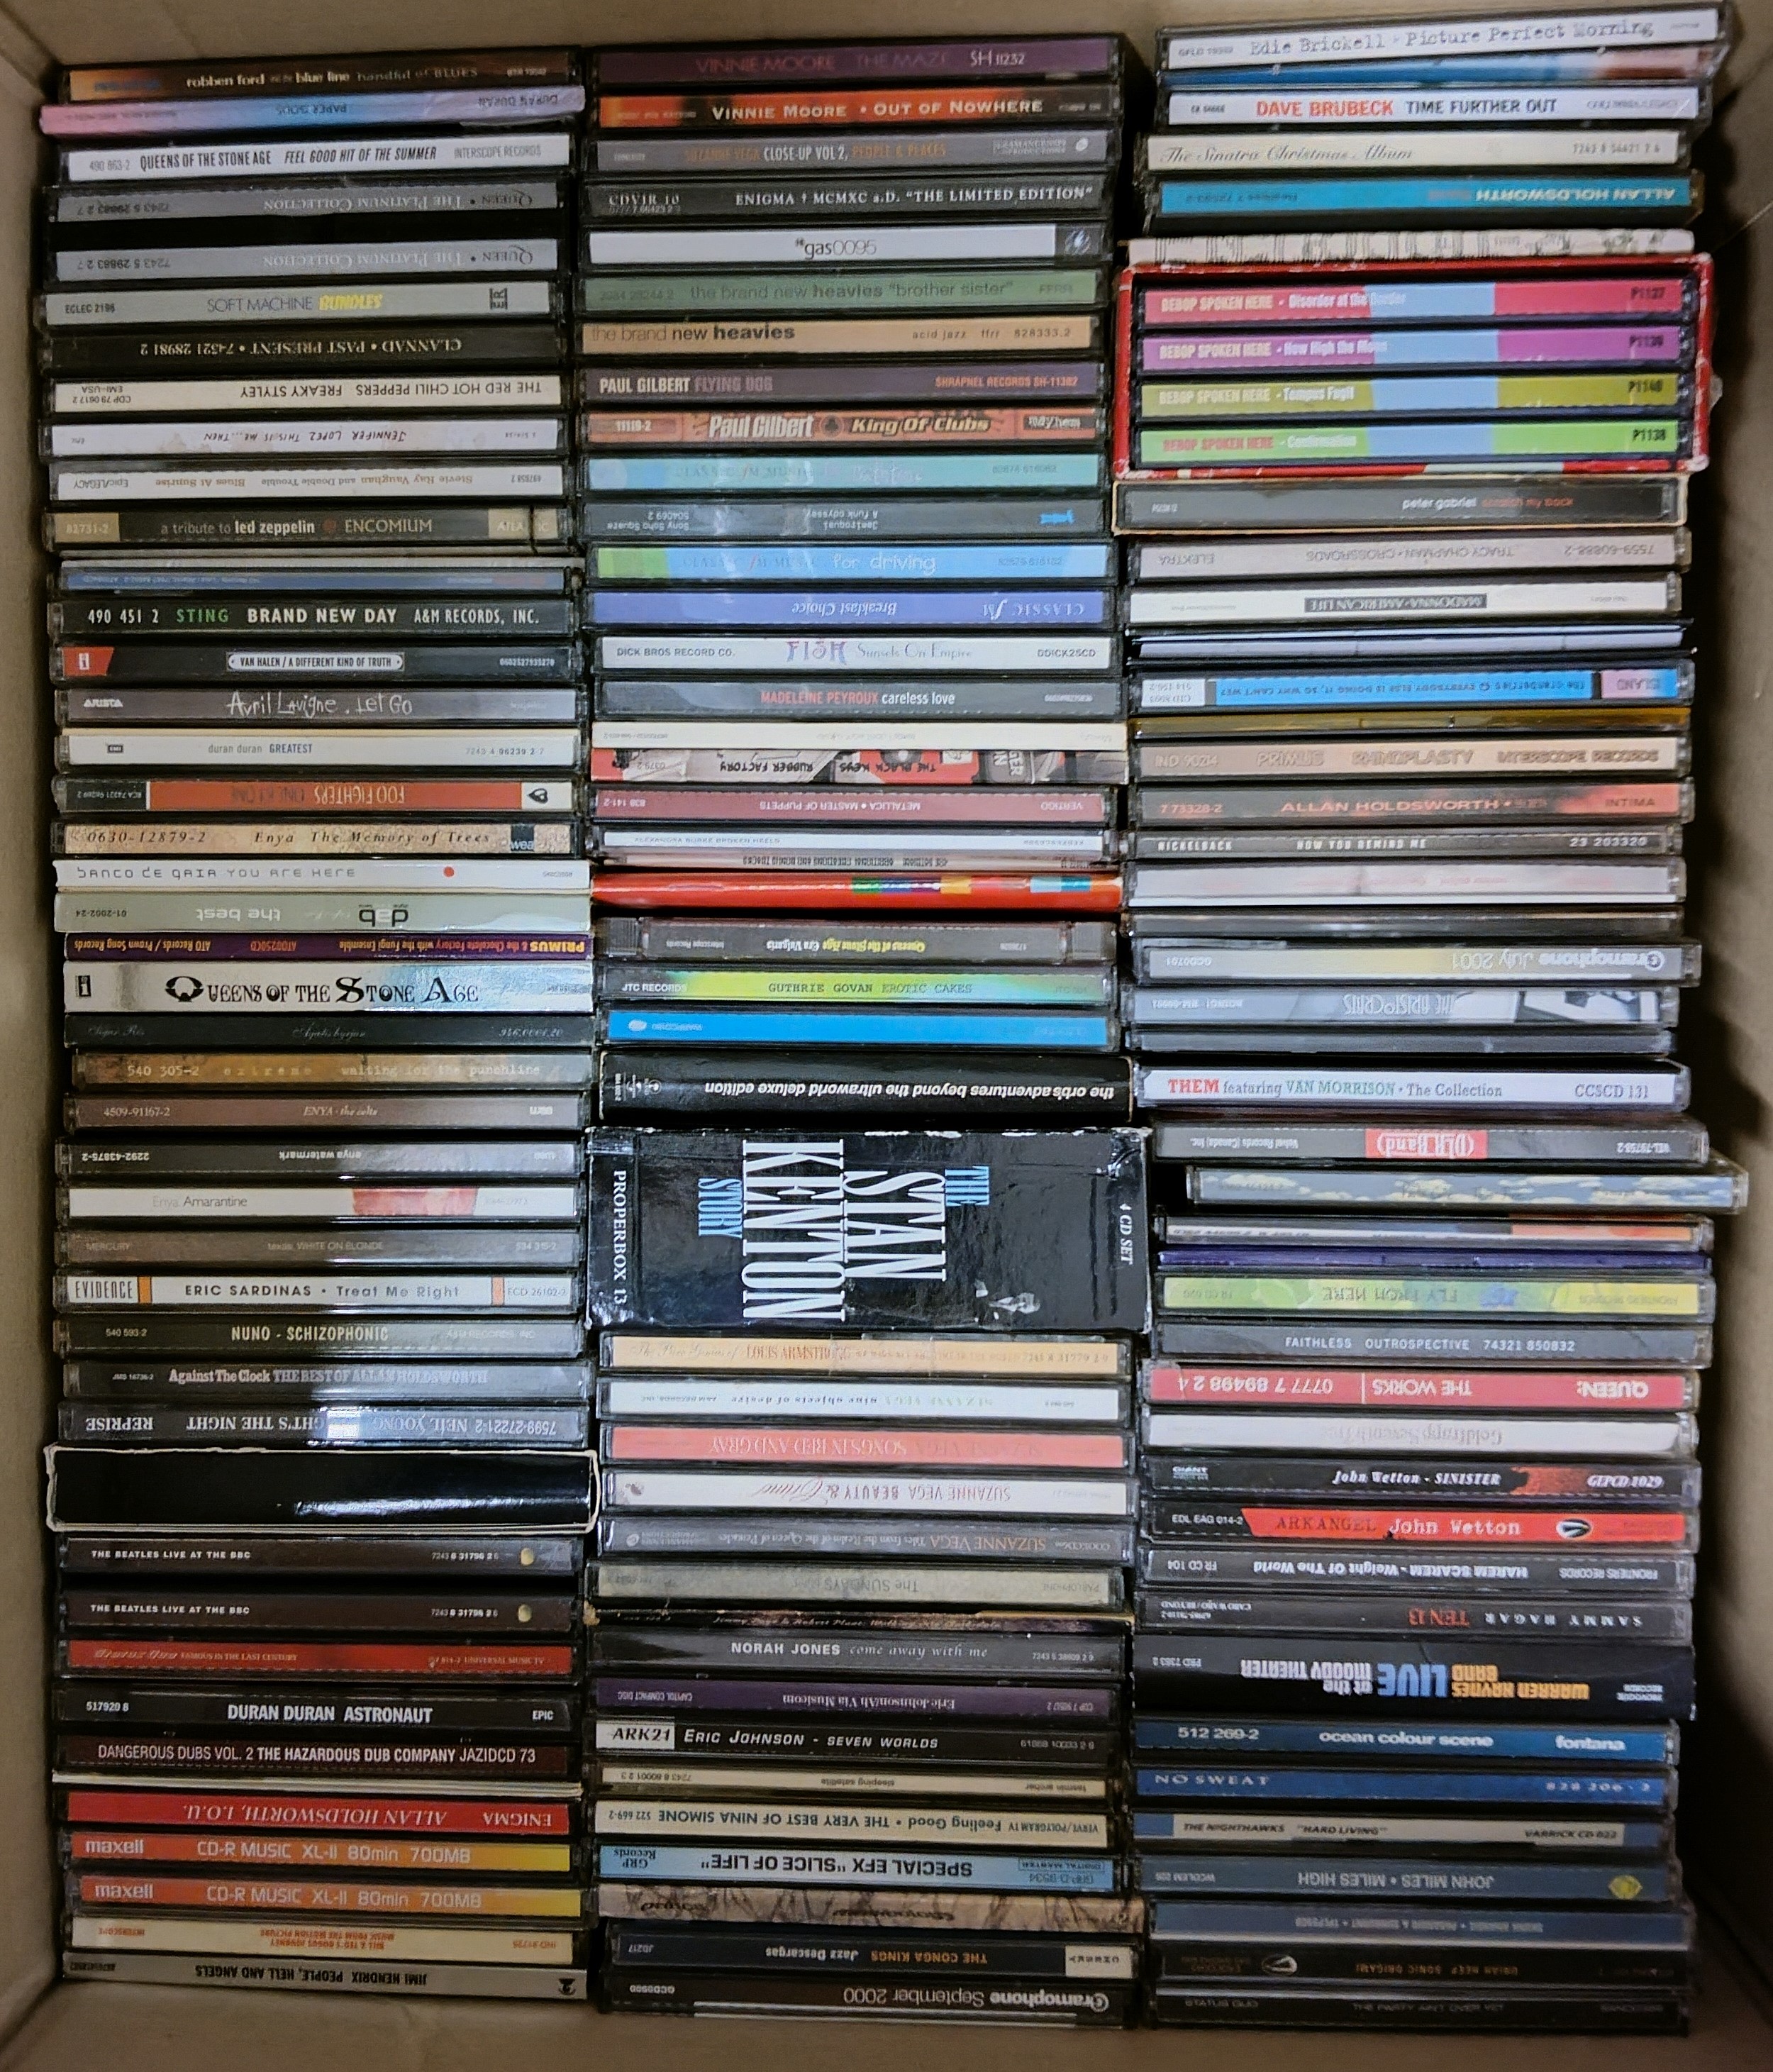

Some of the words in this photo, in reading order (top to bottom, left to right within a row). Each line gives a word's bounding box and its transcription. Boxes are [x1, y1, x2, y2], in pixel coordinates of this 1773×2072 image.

[711, 105, 776, 120] VINNIE
[782, 104, 847, 118] MOORE
[873, 101, 913, 116] OUT
[918, 101, 943, 114] OF
[949, 98, 1043, 113] NOWHERE
[1256, 100, 1303, 118] DAVE
[1308, 99, 1394, 116] BRUBECK
[1405, 99, 1445, 116] TIME
[1449, 97, 1521, 115] FURTHER
[1525, 96, 1557, 113] OUT
[140, 153, 180, 171] QUEENS
[182, 152, 196, 170] OF
[198, 151, 216, 168] THE
[218, 151, 250, 167] STONE
[250, 150, 272, 165] AGE
[284, 150, 307, 165] FEEL
[309, 149, 336, 163] GOOD
[339, 148, 356, 162] HIT
[358, 148, 372, 162] OF
[374, 148, 392, 161] THE
[394, 146, 438, 161] SUMMER
[735, 192, 796, 206] ENIGMA
[813, 191, 869, 205] MCMXC
[950, 188, 1014, 202] LIMITED
[206, 297, 243, 314] SOFT
[247, 296, 313, 311] MACHINE
[318, 293, 383, 310] BUNDLES
[239, 385, 287, 399] STYLEY
[290, 384, 343, 397] FREAKY
[355, 383, 411, 397] PEPPERS
[415, 382, 448, 396] CHILI
[448, 382, 482, 395] HOT
[486, 382, 512, 394] RED
[516, 381, 543, 393] THE
[599, 377, 633, 394] PAUL
[636, 377, 690, 392] GILBERT
[162, 523, 167, 534] a
[172, 521, 215, 536] tribute
[218, 521, 231, 534] to
[234, 519, 255, 533] led
[258, 519, 316, 537] zeppelin
[344, 518, 433, 533] ENCOMIUM
[176, 608, 229, 624] STING
[247, 608, 308, 624] BRAND
[316, 608, 356, 624] NEW
[364, 608, 397, 624] DAY
[760, 690, 824, 705] MADELEINE
[826, 690, 879, 706] PEYROUX
[882, 690, 928, 705] careless
[931, 690, 955, 705] love
[1281, 799, 1351, 812] ALLAN
[1355, 799, 1498, 812] HOLDSWORTH
[1569, 837, 1587, 847] 23
[1592, 836, 1647, 848] 203320
[704, 1081, 754, 1095] edition
[757, 1081, 806, 1096] deluxe
[806, 1082, 882, 1097] ultraworld
[885, 1083, 909, 1097] the
[912, 1082, 967, 1099] beyond
[969, 1084, 1053, 1099] adventures
[1090, 1085, 1115, 1099] the
[1167, 1077, 1220, 1094] THEM
[1223, 1079, 1282, 1098] featuring
[1284, 1079, 1314, 1095] VAN
[1317, 1079, 1396, 1095] MORRISON
[1406, 1082, 1432, 1097] The
[1434, 1082, 1503, 1098] Collection
[1574, 1084, 1625, 1099] CCSCD
[1628, 1084, 1650, 1099] 131
[945, 1165, 990, 1206] THE
[697, 1178, 743, 1240] STORY
[612, 1169, 628, 1281] PROPERBOX
[741, 1139, 846, 1322] KENTON
[845, 1170, 947, 1282] STAN
[1119, 1216, 1133, 1236] CD
[1118, 1240, 1133, 1265] SET
[74, 1280, 133, 1300] EVIDENCE
[184, 1285, 223, 1297] ERIC
[229, 1284, 312, 1297] SARDINAS
[335, 1284, 378, 1297] Treat
[385, 1285, 409, 1298] Me
[416, 1285, 460, 1300] Right
[613, 1287, 628, 1305] 13
[1284, 1336, 1352, 1349] FAITHLESS
[1365, 1337, 1470, 1351] OUTROSPECTIVE
[1483, 1338, 1523, 1351] 74321
[1525, 1339, 1576, 1352] 850832
[1372, 1378, 1437, 1397] WORKS
[1442, 1380, 1473, 1397] THE
[1576, 1380, 1649, 1399] QUEEN:
[1276, 1516, 1377, 1533] ARKANGEL
[1389, 1518, 1438, 1536] John
[1450, 1518, 1520, 1536] Wetton
[231, 1551, 250, 1559] BBC
[730, 1642, 784, 1656] NORAH
[791, 1643, 840, 1656] JONES
[850, 1644, 883, 1657] come
[887, 1644, 926, 1660] away
[931, 1643, 962, 1658] with
[968, 1646, 988, 1658] me
[227, 1705, 279, 1722] DURAN
[283, 1705, 335, 1722] DURAN
[344, 1706, 433, 1724] ASTRONAUT
[532, 1710, 554, 1722] EPIC
[612, 1727, 671, 1743] ARK21
[684, 1730, 721, 1744] ERIC
[729, 1730, 804, 1747] JOHNSON
[828, 1737, 872, 1746] SEVEN
[880, 1736, 938, 1749] WORLDS
[1177, 1726, 1211, 1740] 512
[1213, 1727, 1260, 1741] 269-2
[1319, 1732, 1374, 1744] ocean
[1377, 1732, 1436, 1746] colour
[1438, 1734, 1494, 1748] scene
[1555, 1734, 1625, 1751] fontana
[98, 1744, 174, 1760] DANGEROUS
[177, 1745, 212, 1761] DUBS
[213, 1746, 243, 1761] VOL.
[245, 1746, 254, 1761] 2
[257, 1746, 282, 1762] THE
[284, 1747, 361, 1763] HAZARDOUS
[364, 1747, 391, 1763] DUB
[394, 1747, 455, 1764] COMPANY
[459, 1747, 516, 1764] JAZIDCD
[518, 1748, 536, 1763] 73
[1155, 1773, 1186, 1785] NO
[1195, 1775, 1270, 1787] SWEAT
[85, 1839, 144, 1854] maxell
[197, 1841, 236, 1858] CD-R
[241, 1842, 292, 1859] MUSIC
[348, 1845, 399, 1862] 80min
[411, 1846, 470, 1863] 700MB
[752, 1854, 778, 1871] OF
[851, 1858, 889, 1874] EFX
[892, 1859, 973, 1877] SPECIAL
[1298, 1872, 1337, 1886] HIGH
[1340, 1873, 1385, 1887] MILES
[1401, 1873, 1447, 1888] MILES
[1450, 1873, 1494, 1890] JOHN
[843, 1987, 888, 2004] 2000
[891, 1988, 984, 2007] September
